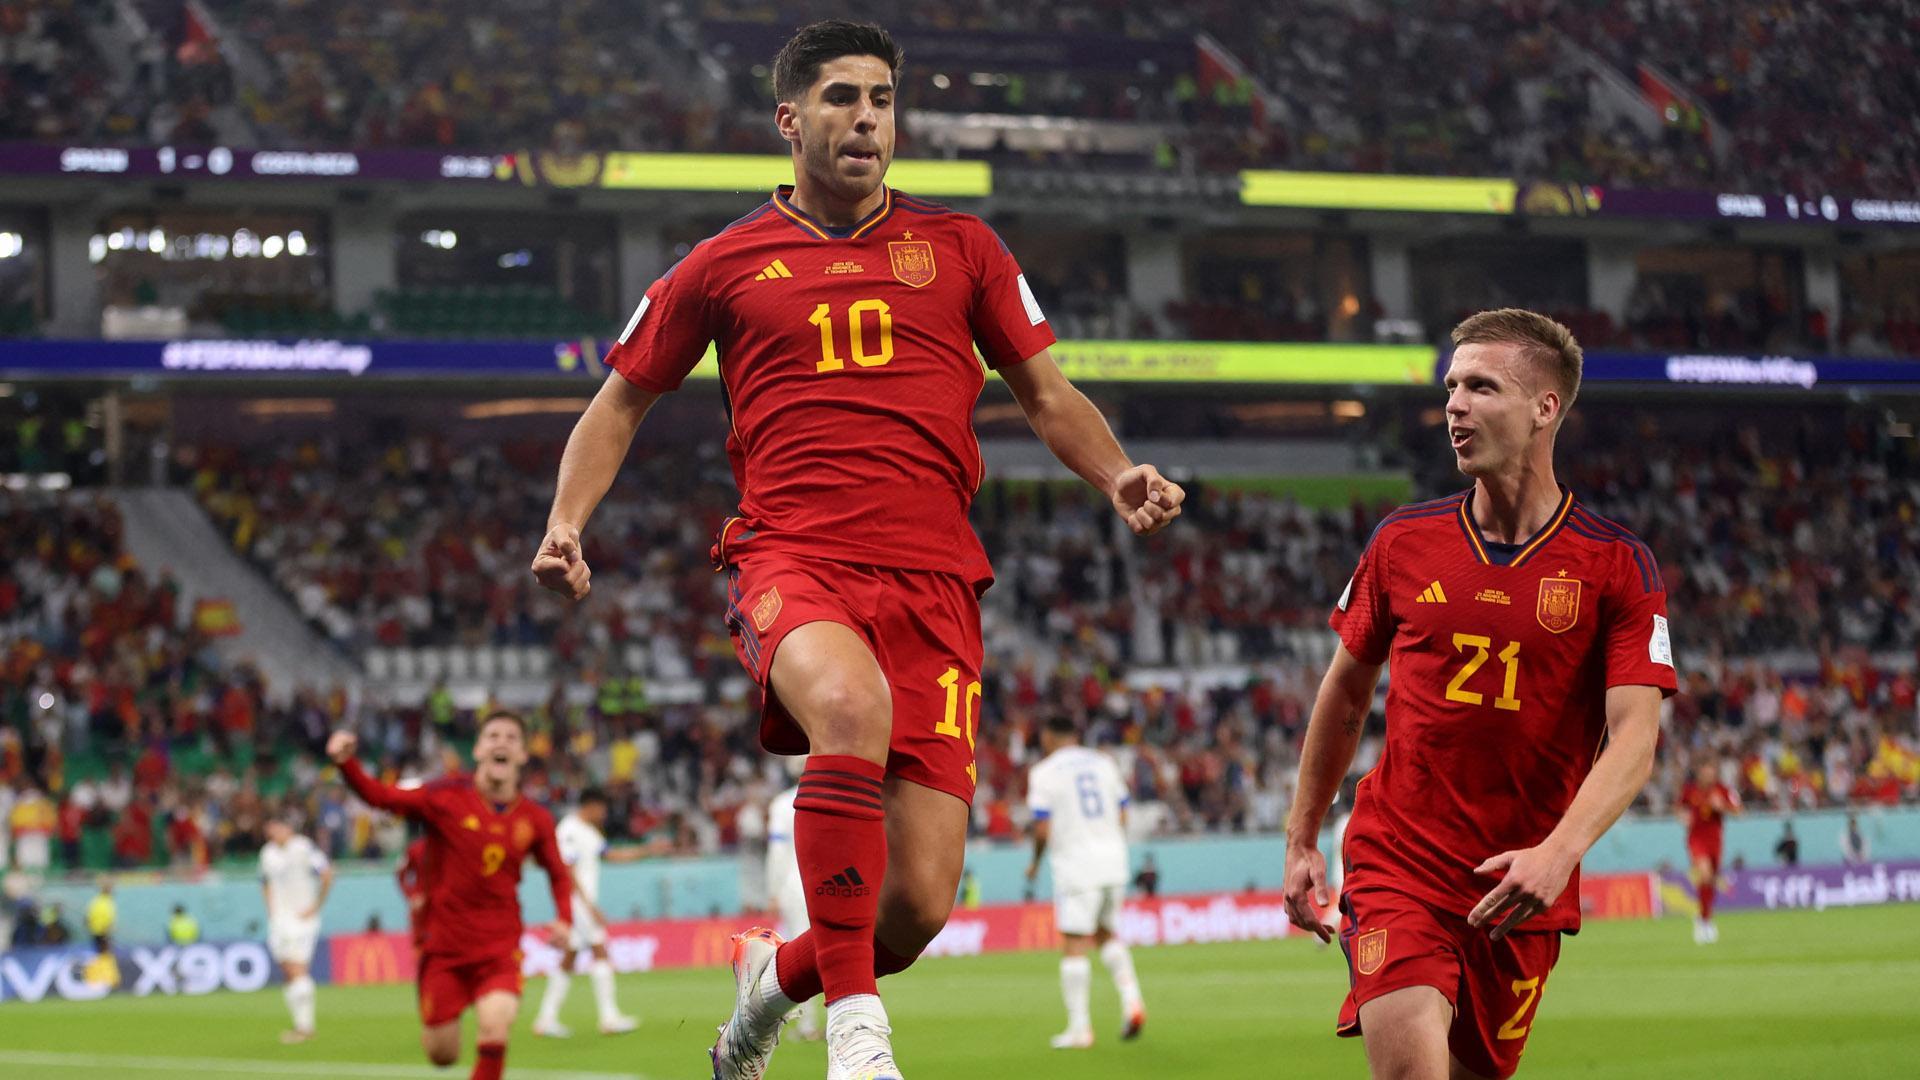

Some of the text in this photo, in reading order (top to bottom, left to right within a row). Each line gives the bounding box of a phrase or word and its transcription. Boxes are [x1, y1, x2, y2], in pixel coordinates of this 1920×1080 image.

[808, 298, 895, 374] 10
[1445, 632, 1521, 711] 21
[1075, 770, 1104, 819] 6
[481, 842, 507, 877] 9
[815, 882, 872, 898] adidas
[132, 944, 271, 995] X90
